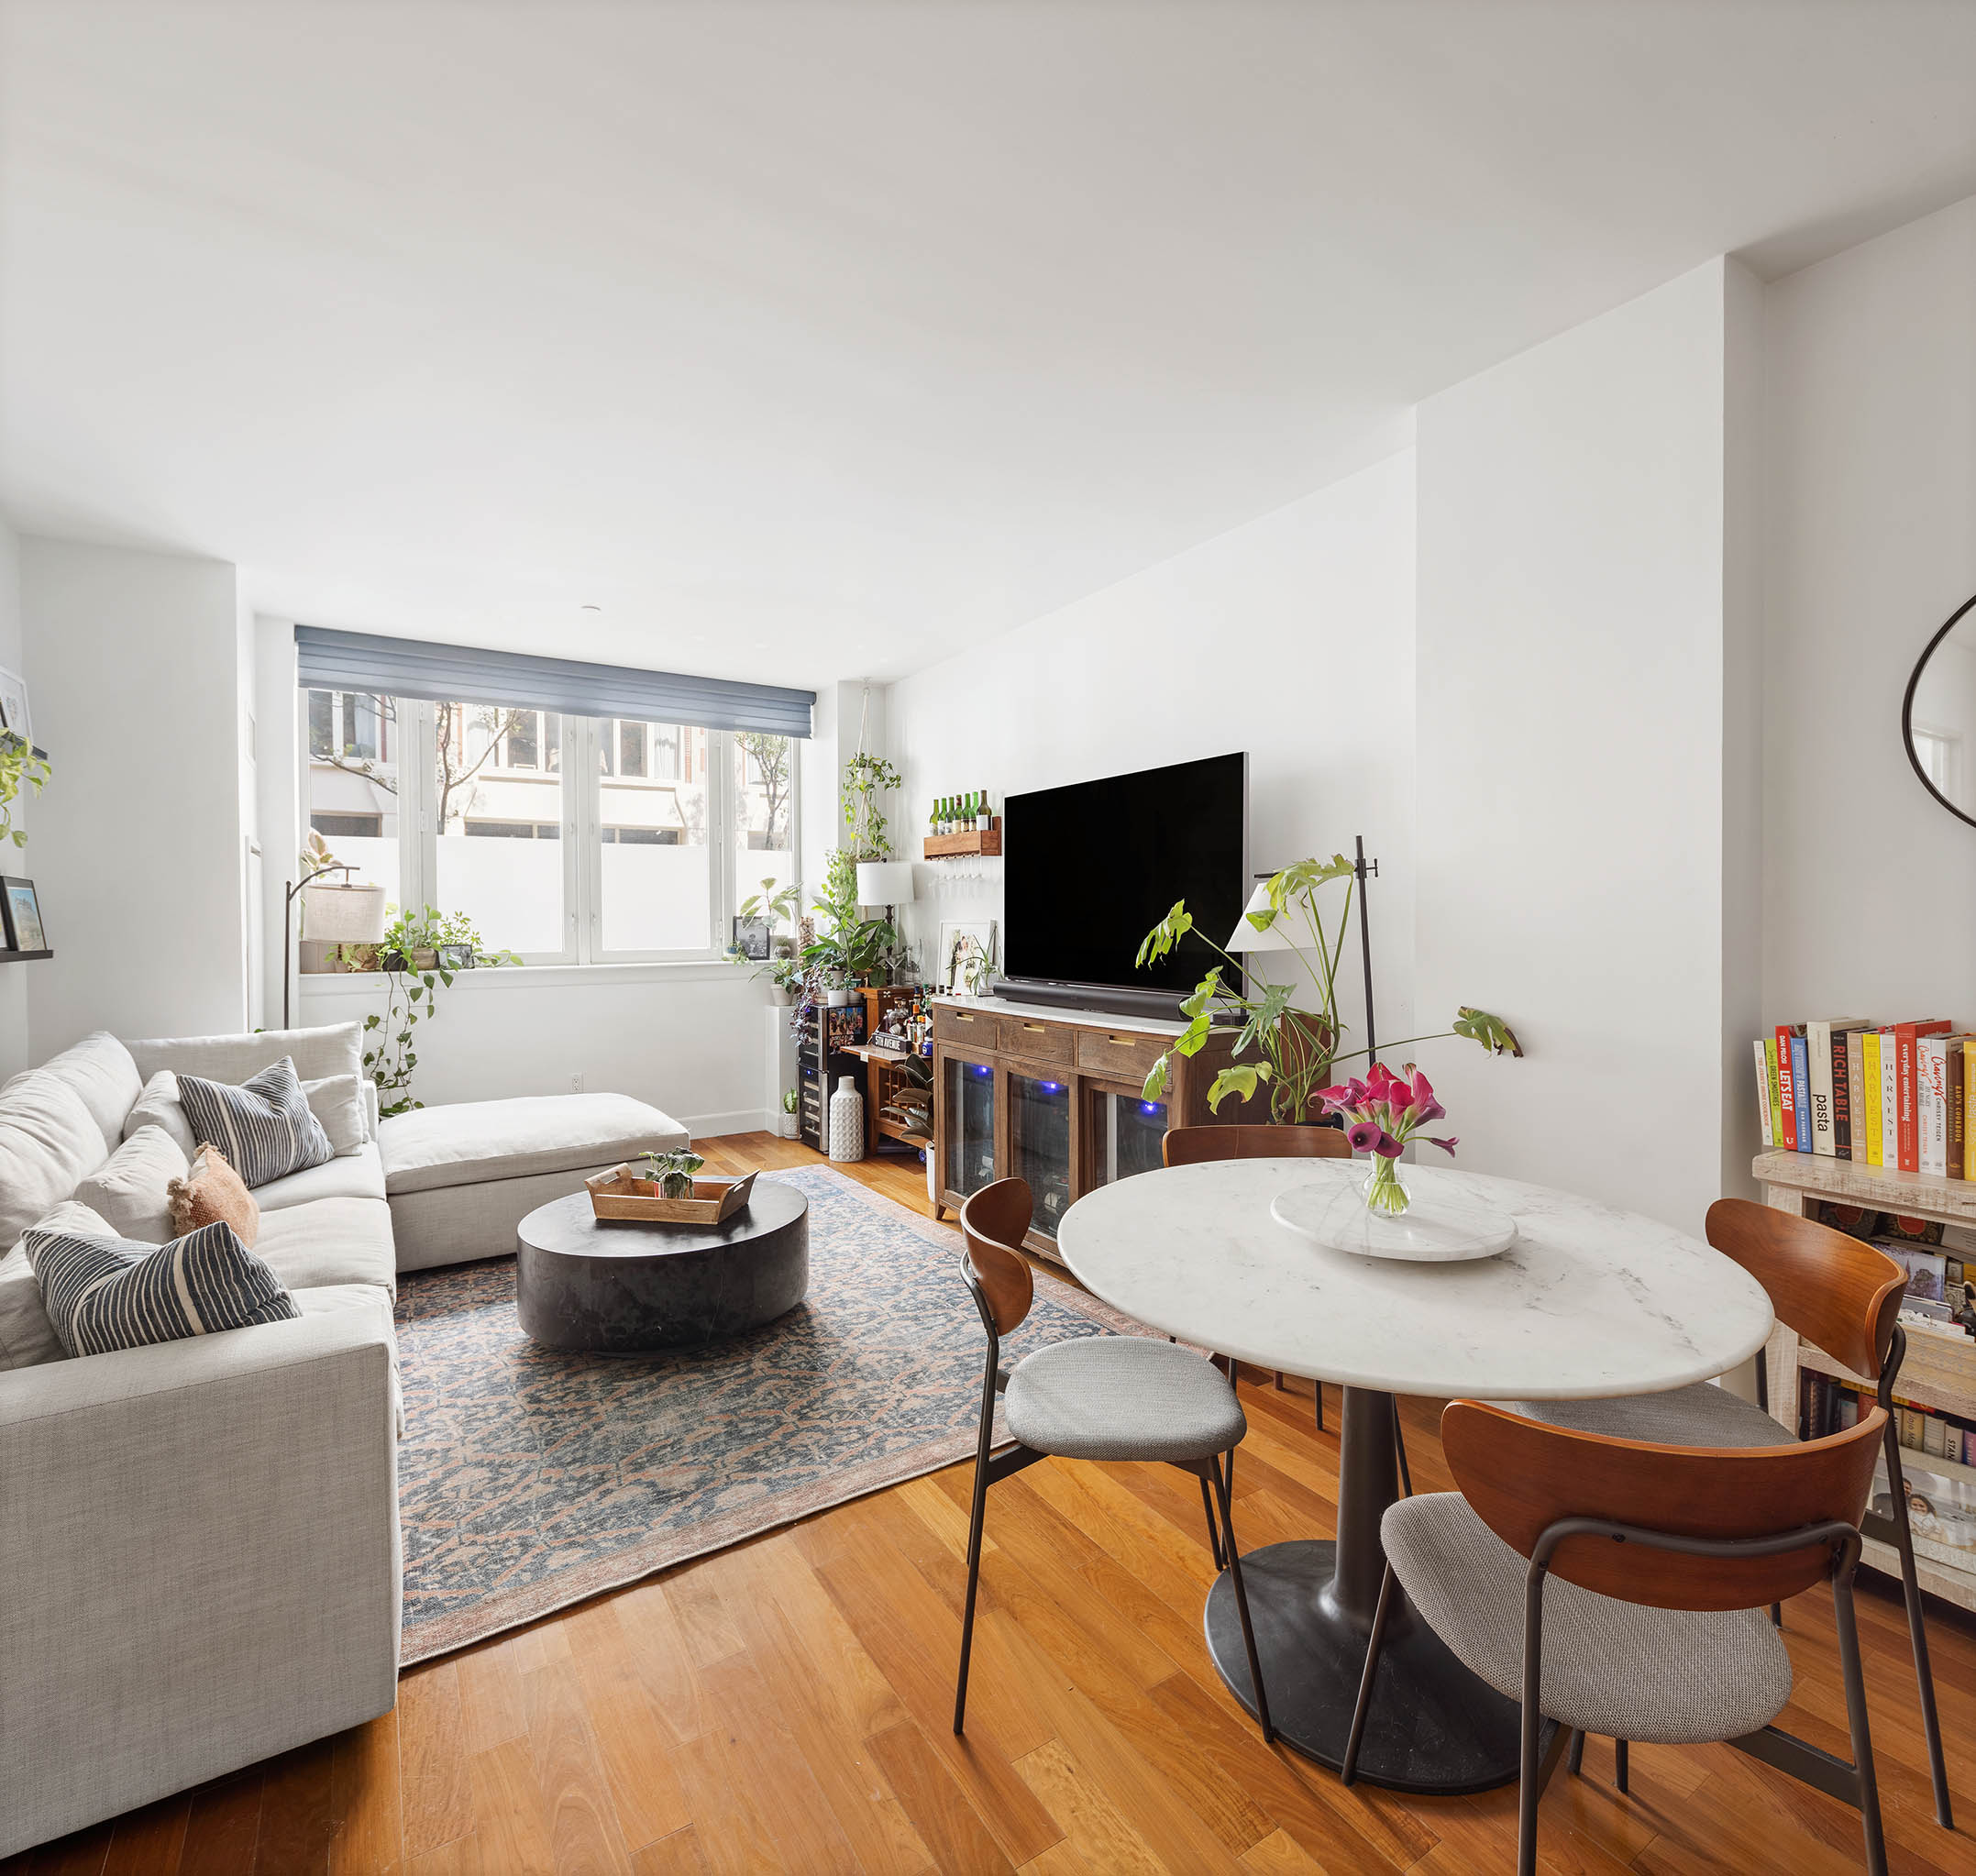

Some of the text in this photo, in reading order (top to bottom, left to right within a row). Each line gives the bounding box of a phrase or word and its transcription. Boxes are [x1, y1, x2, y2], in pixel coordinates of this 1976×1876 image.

[884, 1038, 900, 1051] AVENUE
[1833, 1045, 1847, 1078] RICH
[1901, 1043, 1911, 1076] everyday
[1917, 1045, 1932, 1084] Cravings
[1771, 1081, 1780, 1107] SMOOTHIES
[1780, 1070, 1793, 1111] LET'S EAT
[1868, 1062, 1878, 1137] HARVEST
[1901, 1076, 1912, 1122] entertaining
[1931, 1056, 1947, 1103] Cravings
[1812, 1094, 1830, 1131] pasta
[1834, 1082, 1849, 1122] TABLE
[1852, 1063, 1862, 1137] HARVEST
[1885, 1064, 1893, 1136] HARVEST
